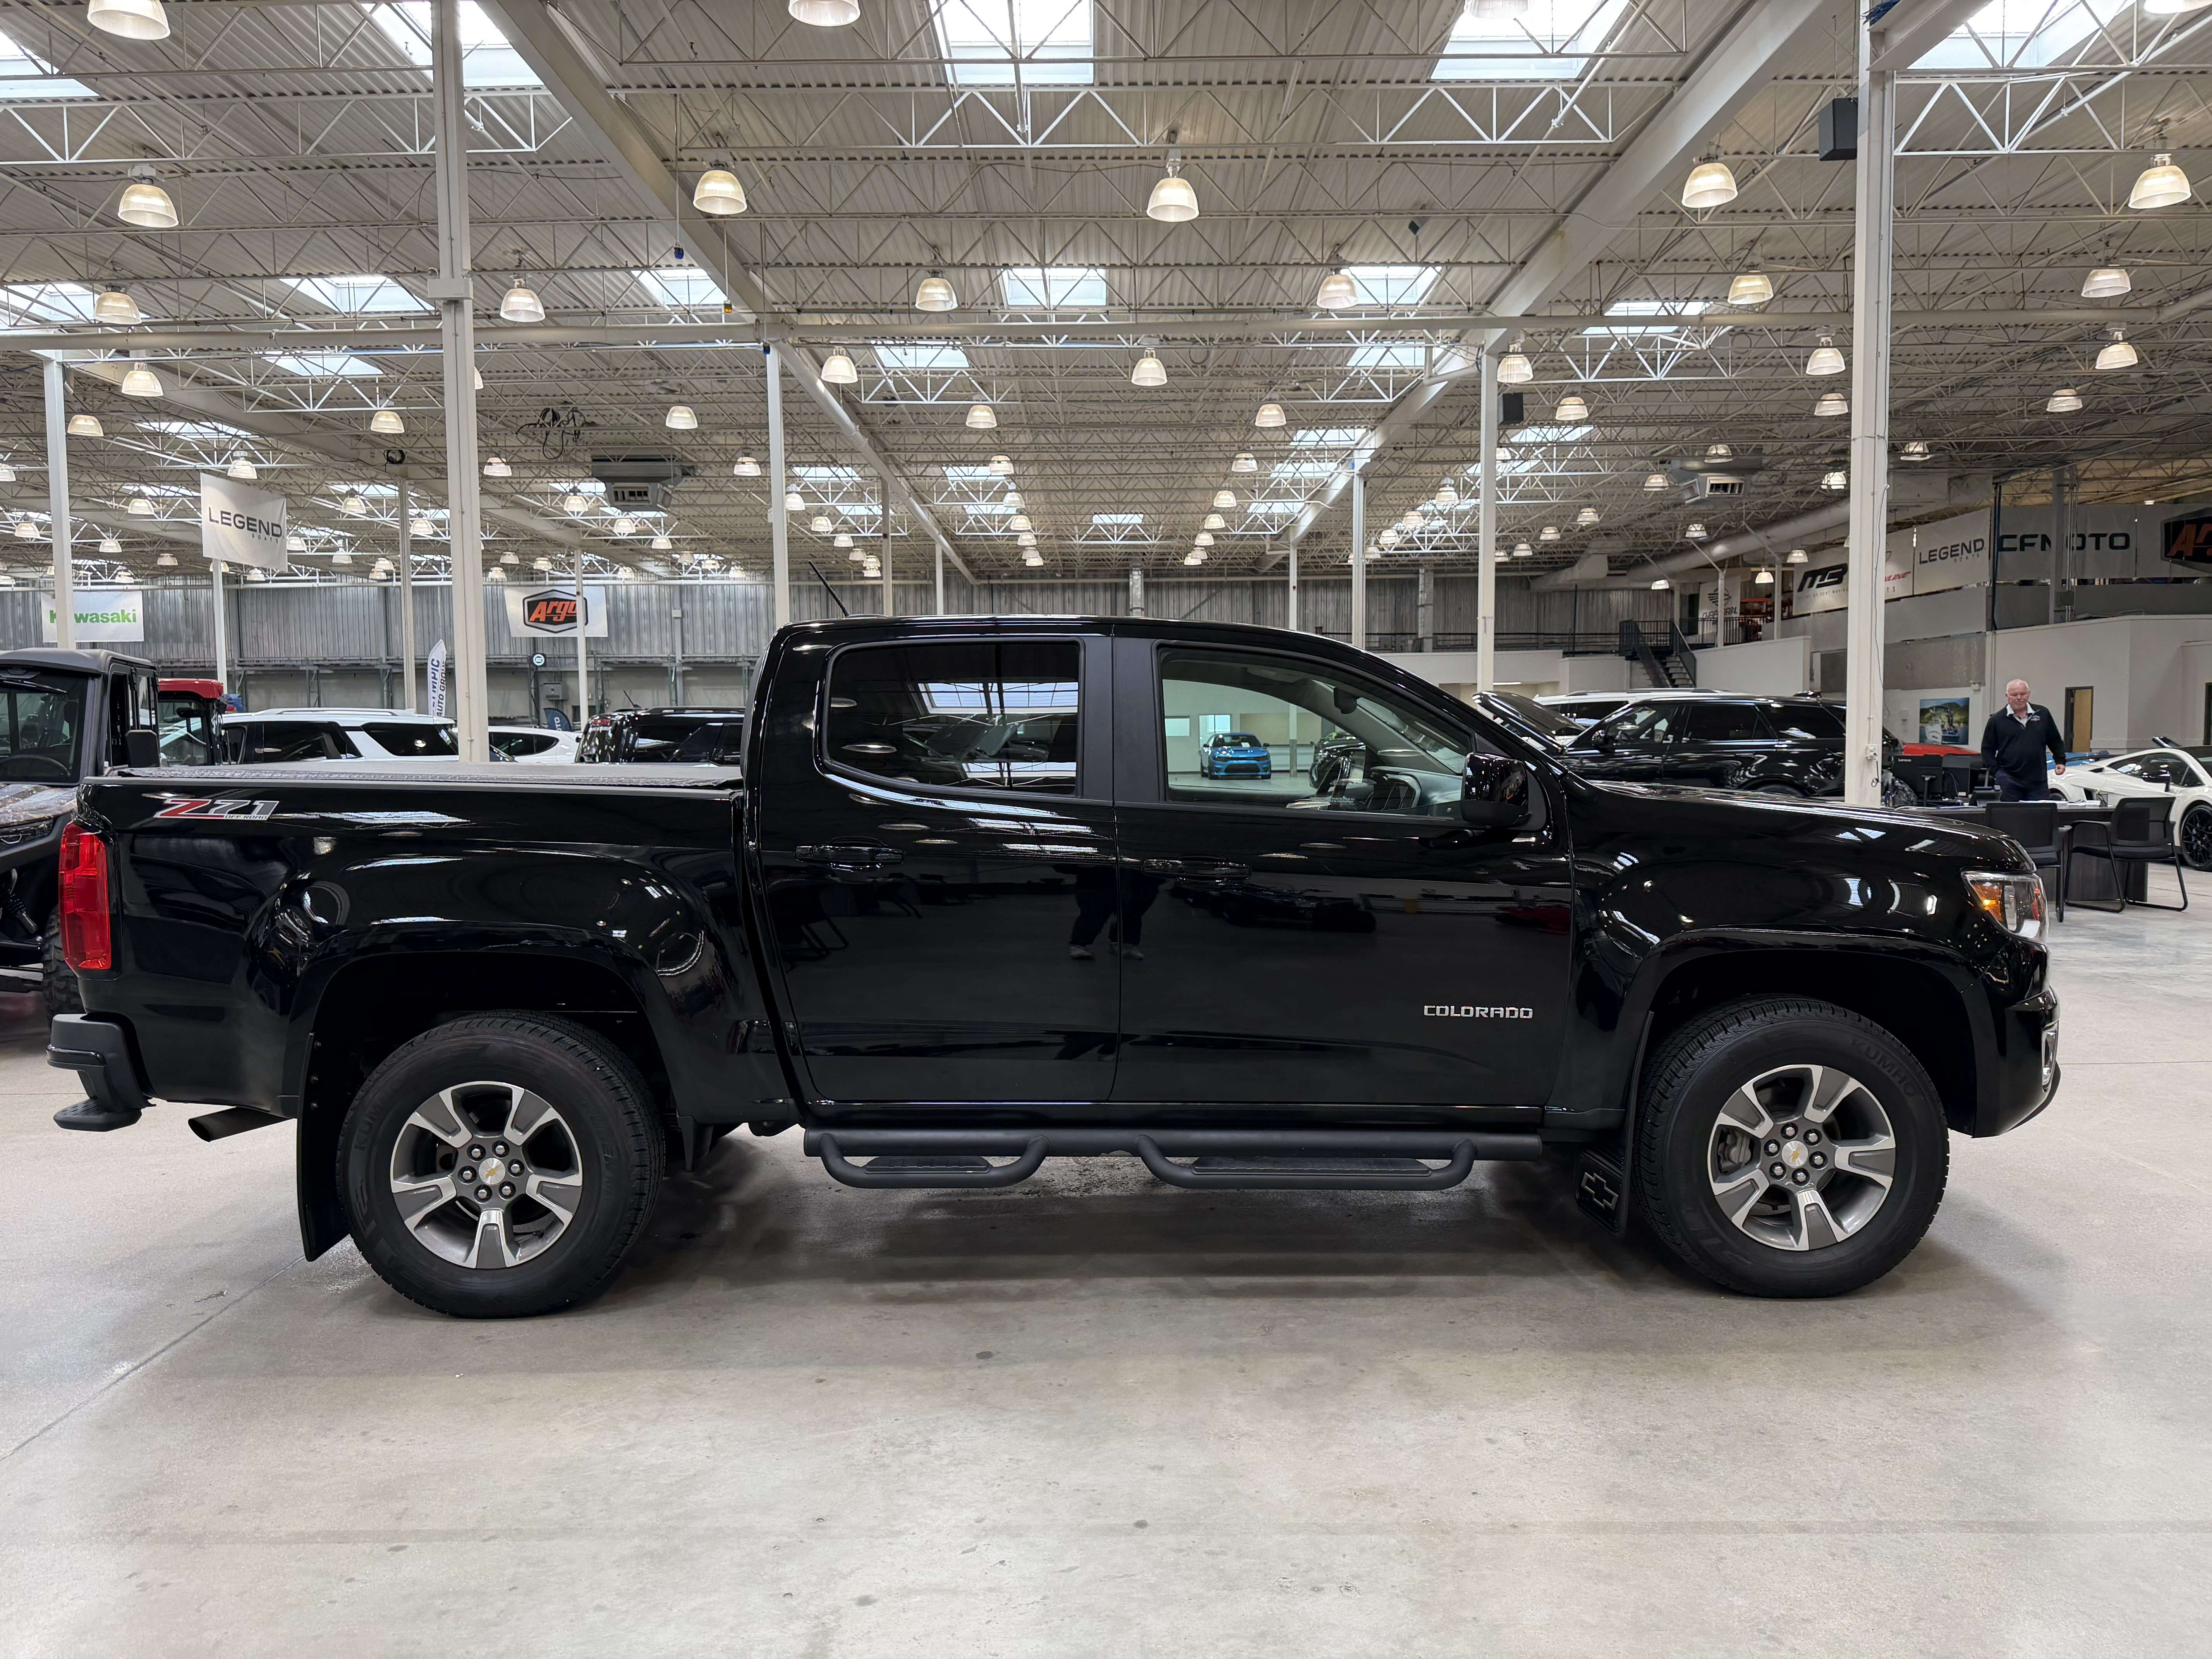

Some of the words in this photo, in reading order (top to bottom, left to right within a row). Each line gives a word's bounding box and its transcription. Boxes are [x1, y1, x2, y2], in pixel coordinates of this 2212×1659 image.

[209, 507, 282, 538] LEGEND
[252, 533, 278, 543] BOATS
[1920, 539, 1984, 564] LEGEND
[50, 609, 136, 623] Kwasaki
[154, 799, 279, 819] Z71
[1424, 1005, 1533, 1018] COLORADO
